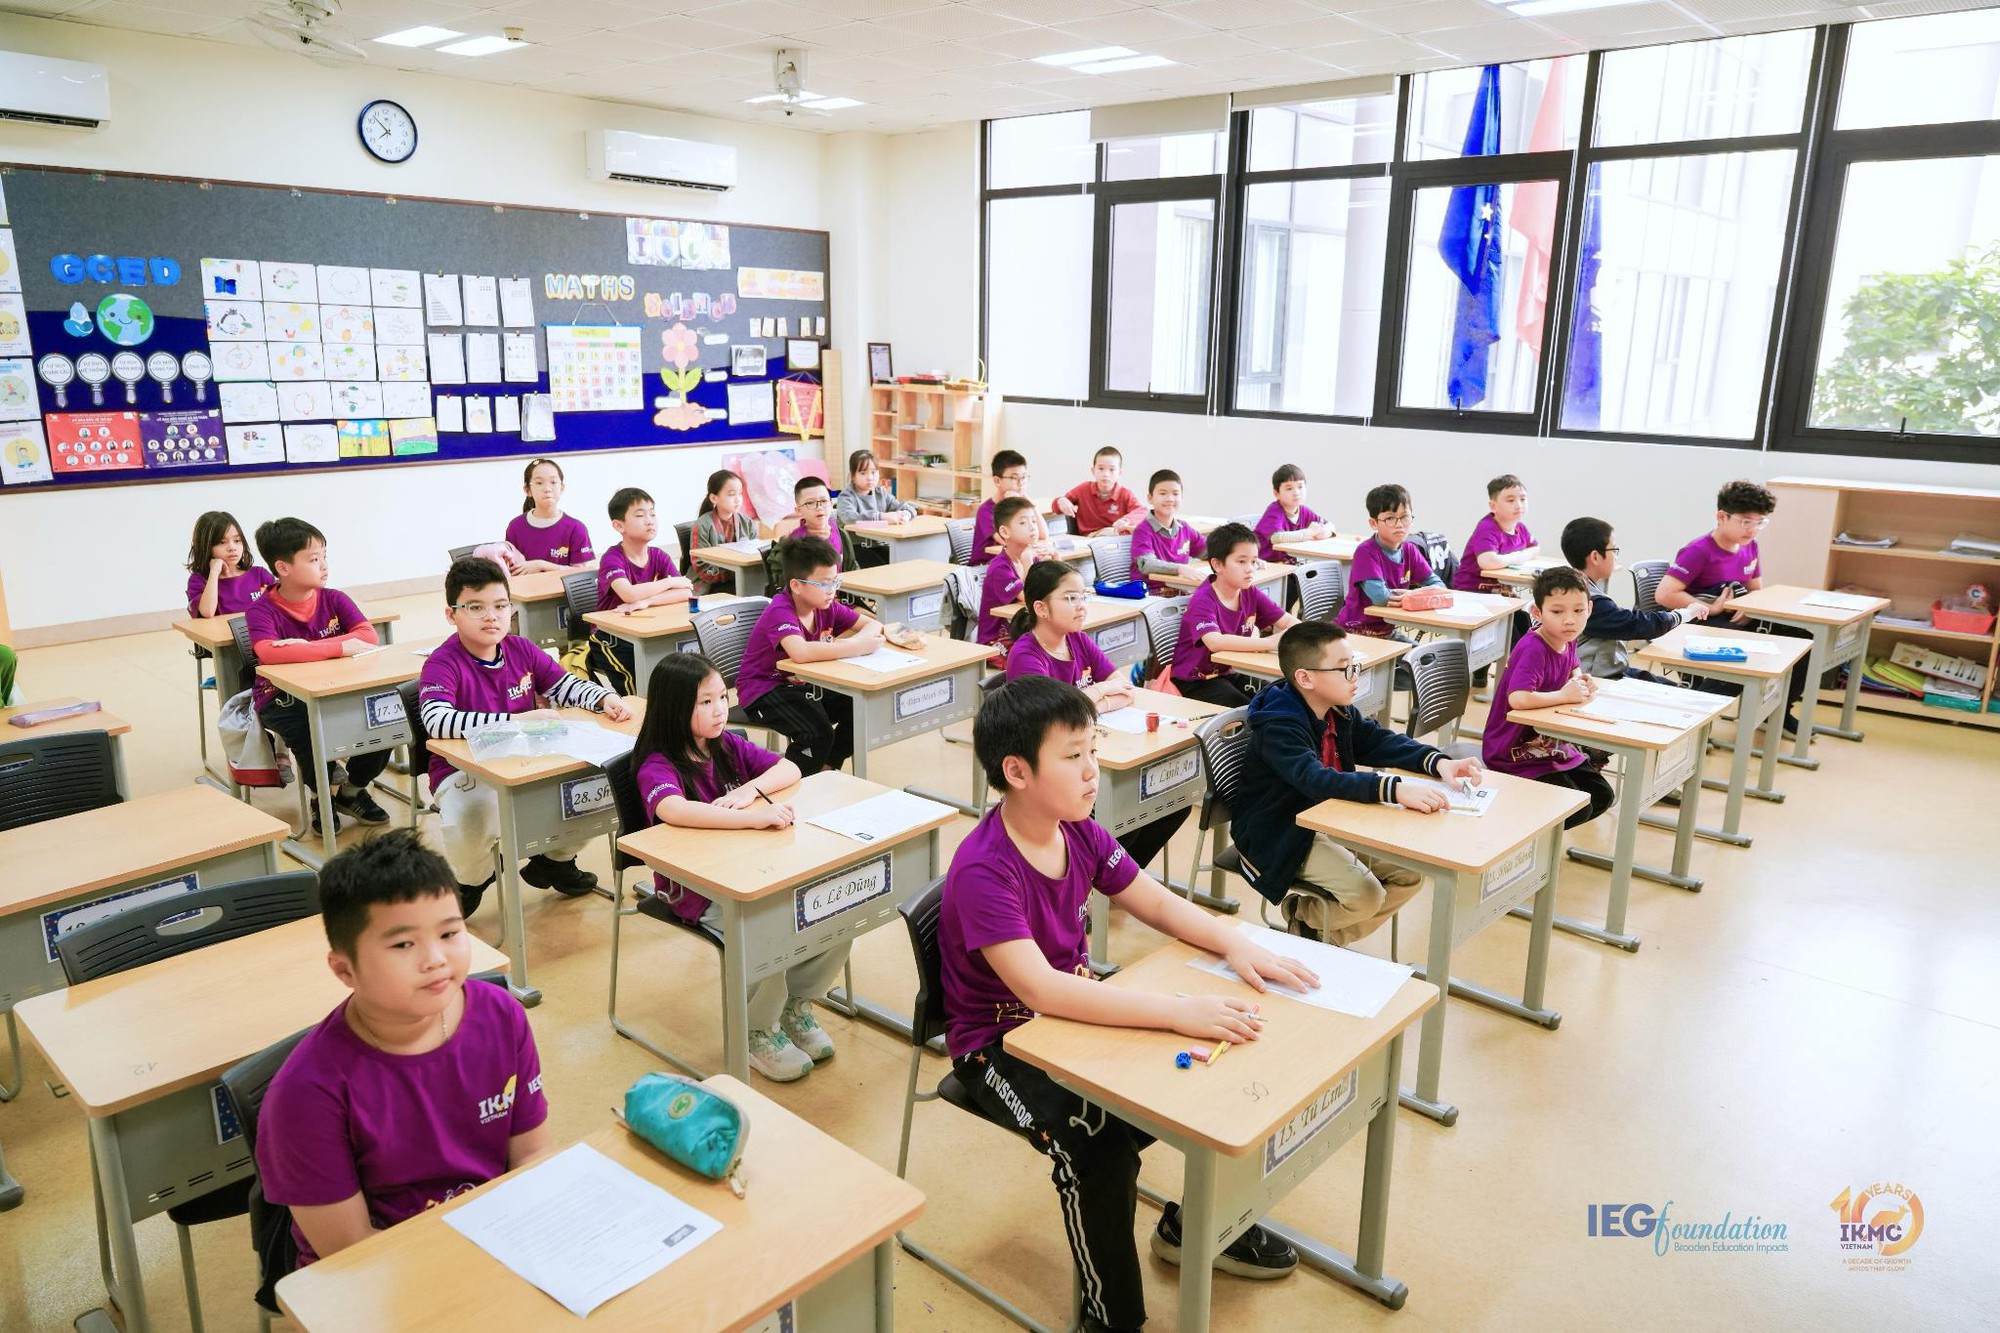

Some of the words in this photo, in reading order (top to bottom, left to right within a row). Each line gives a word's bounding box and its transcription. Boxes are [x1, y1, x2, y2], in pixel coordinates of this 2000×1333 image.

[50, 253, 182, 286] GCED
[545, 273, 635, 301] MATHS
[574, 791, 591, 805] 28.
[594, 784, 612, 801] Sh
[812, 894, 822, 910] 6.
[826, 885, 842, 905] Lê
[1278, 1117, 1296, 1148] 15.
